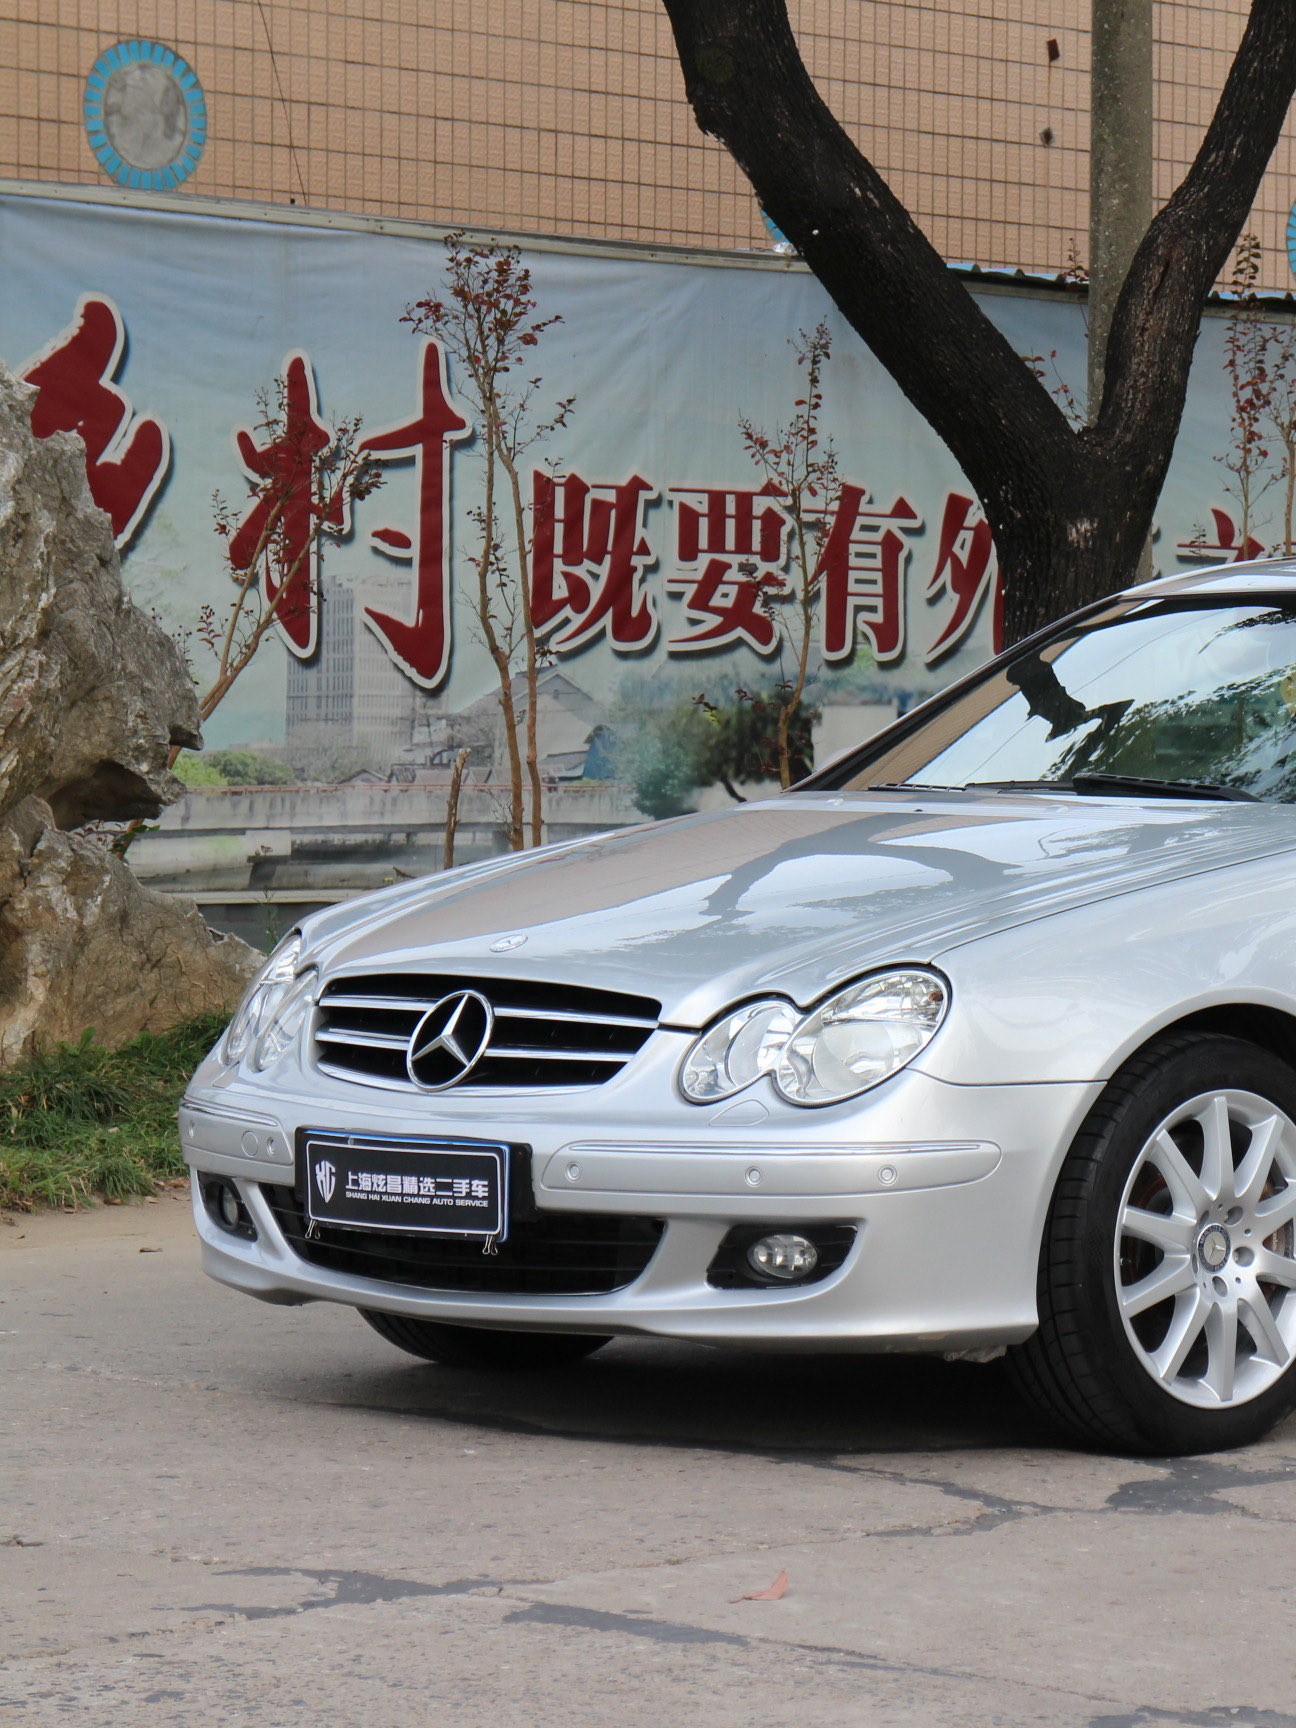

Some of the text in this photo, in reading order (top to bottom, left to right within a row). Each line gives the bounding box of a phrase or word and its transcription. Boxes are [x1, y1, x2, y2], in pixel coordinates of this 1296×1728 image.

[345, 1171, 489, 1198] 上海炫昌精选二手车
[345, 1191, 489, 1208] SHANG HAI XUAN CHANG AUTO SERVICE
